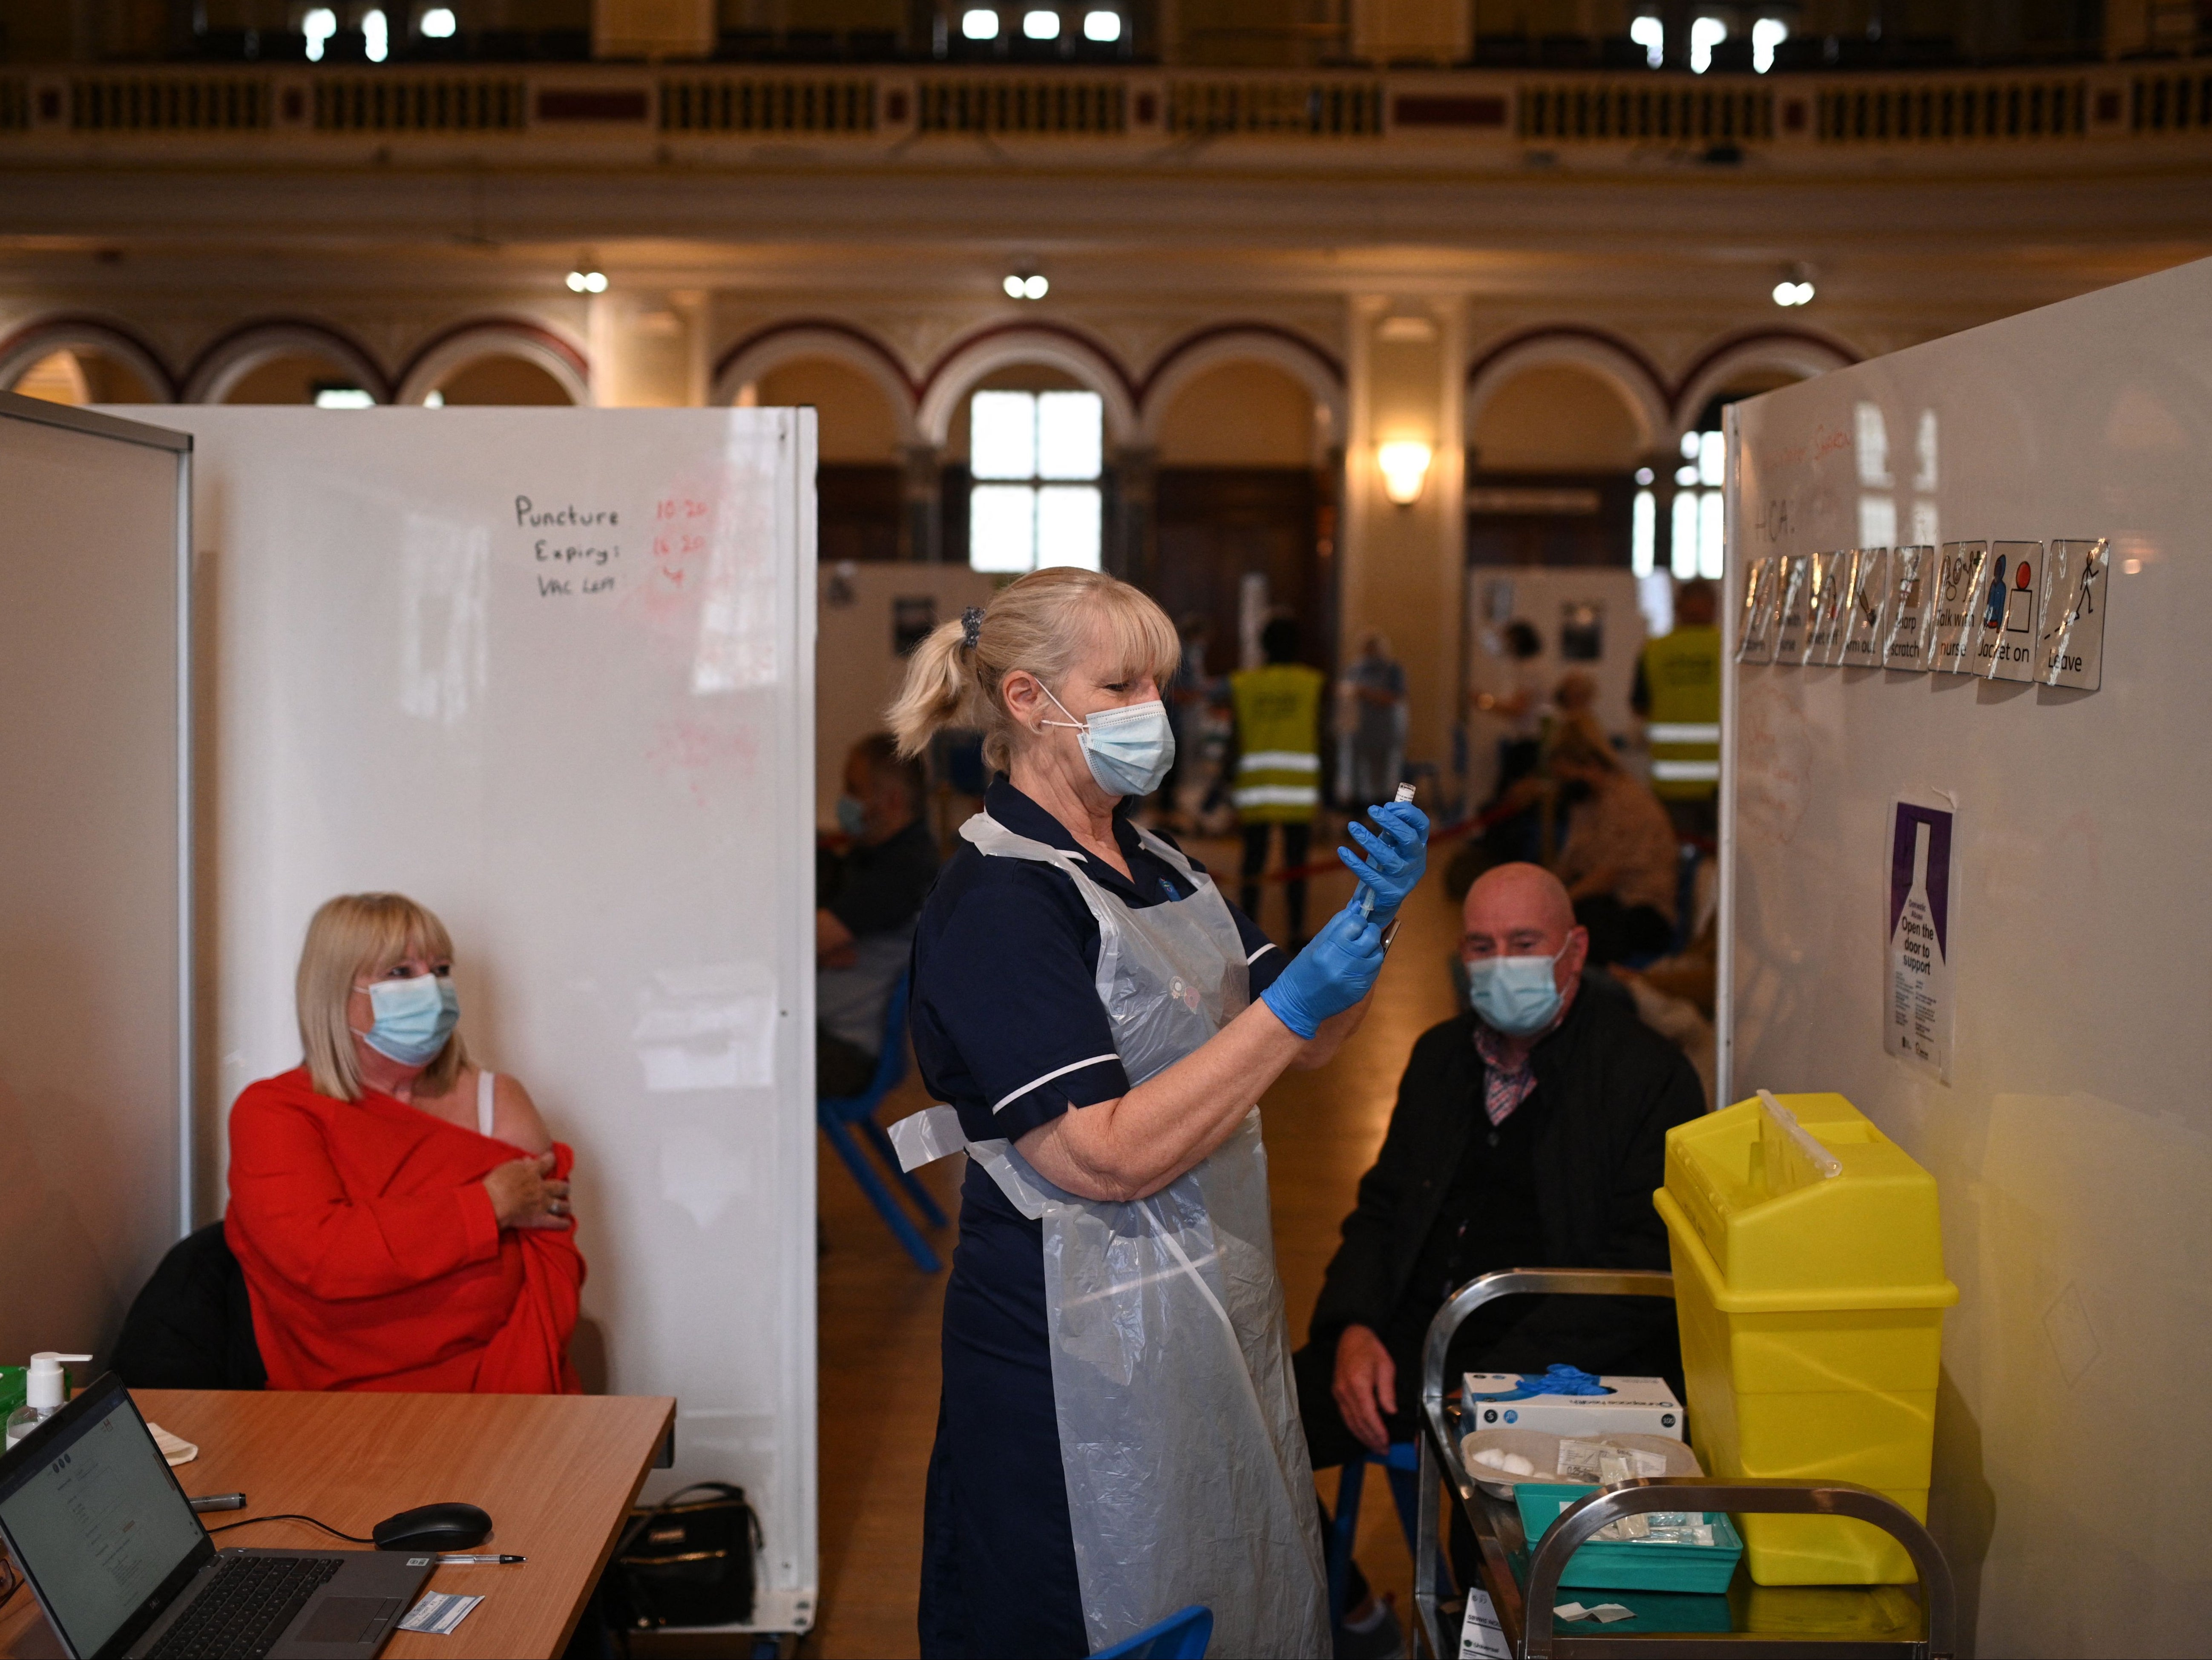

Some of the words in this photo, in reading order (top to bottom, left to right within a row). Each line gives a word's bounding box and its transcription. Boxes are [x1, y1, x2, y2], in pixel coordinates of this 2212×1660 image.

[515, 495, 619, 528] Puncture
[1937, 608, 1952, 626] Talk
[1954, 611, 1975, 627] with
[1891, 640, 1919, 658] scratch
[1940, 642, 1967, 656] nurse
[1978, 638, 2011, 661] Jacket
[2014, 647, 2029, 663] on
[2048, 649, 2082, 672] Leave
[1902, 916, 1921, 937] Open
[1922, 924, 1934, 941] the
[1905, 937, 1921, 955] door
[1922, 943, 1930, 959] to
[1904, 955, 1931, 975] support
[1487, 1412, 1494, 1420] S
